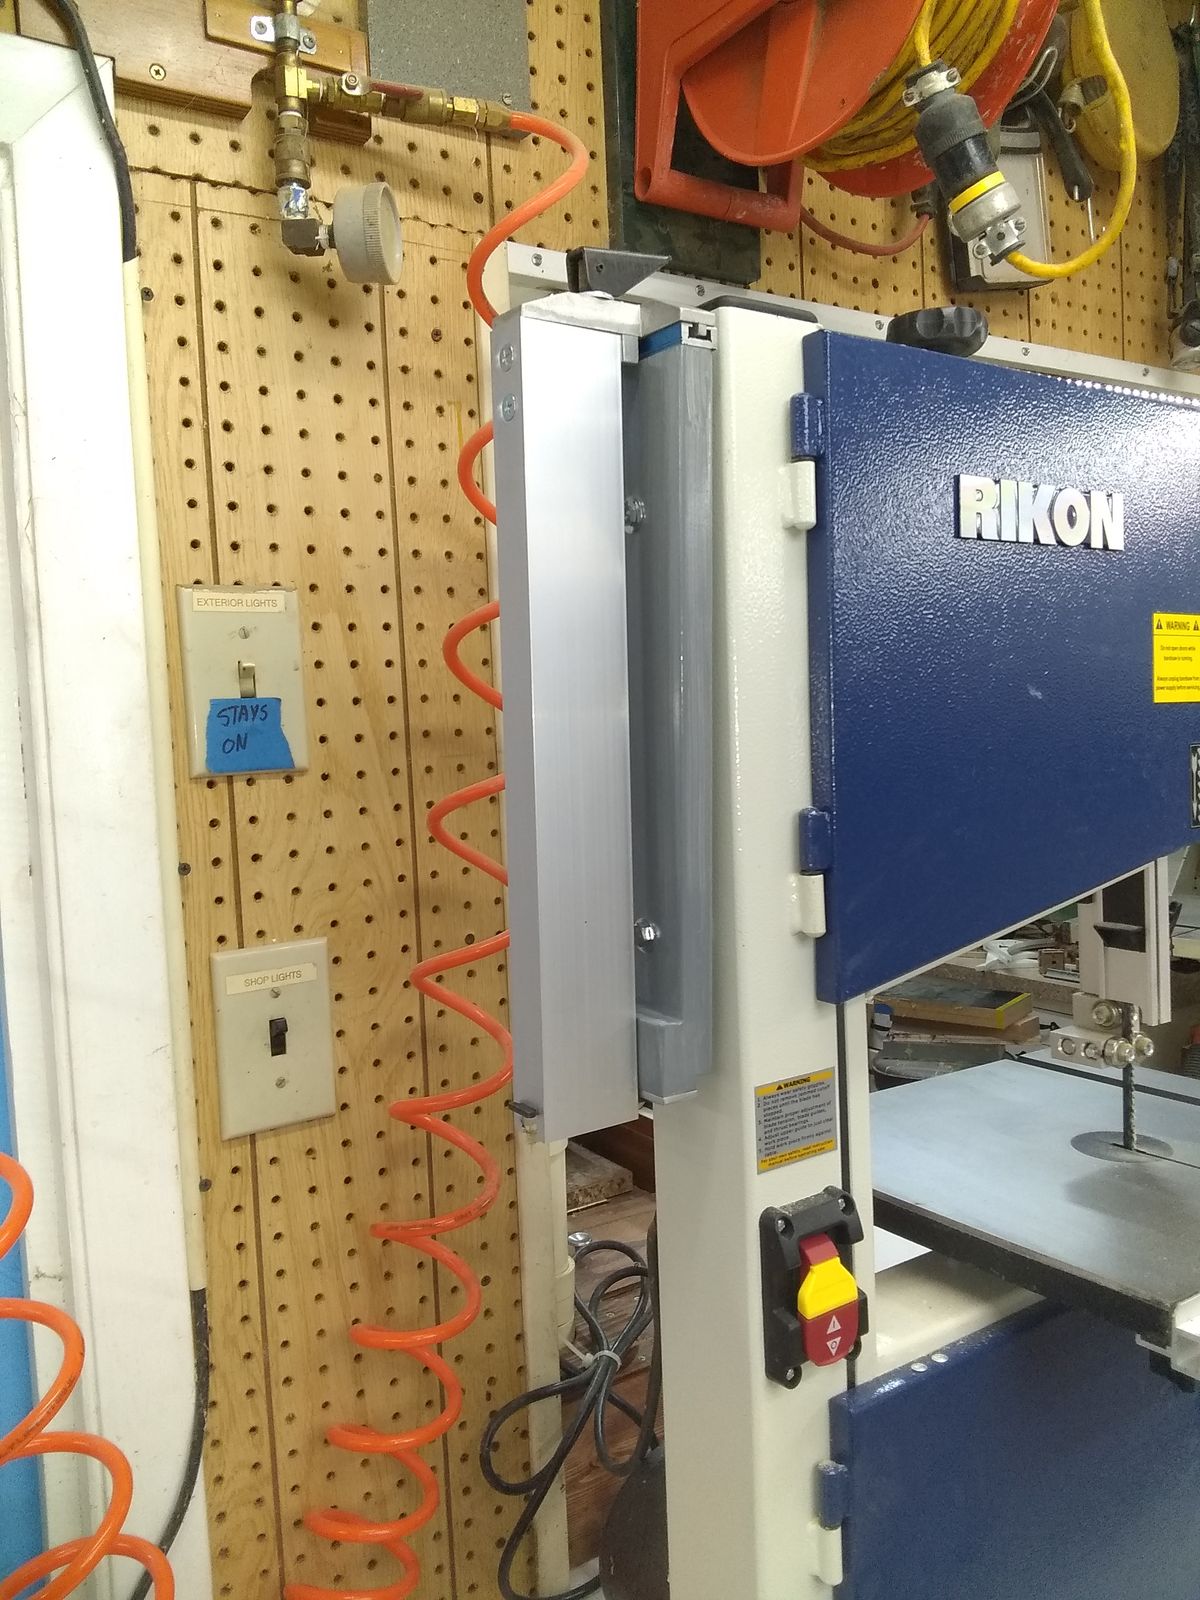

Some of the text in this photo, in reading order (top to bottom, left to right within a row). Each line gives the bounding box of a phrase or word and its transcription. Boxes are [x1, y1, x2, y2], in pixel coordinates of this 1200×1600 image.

[957, 473, 1125, 551] RIKON
[196, 597, 278, 608] EXTERIOR LIGHTS
[216, 704, 269, 727] STAYS
[222, 733, 248, 754] ON
[244, 970, 303, 988] SHOP LIGHTS
